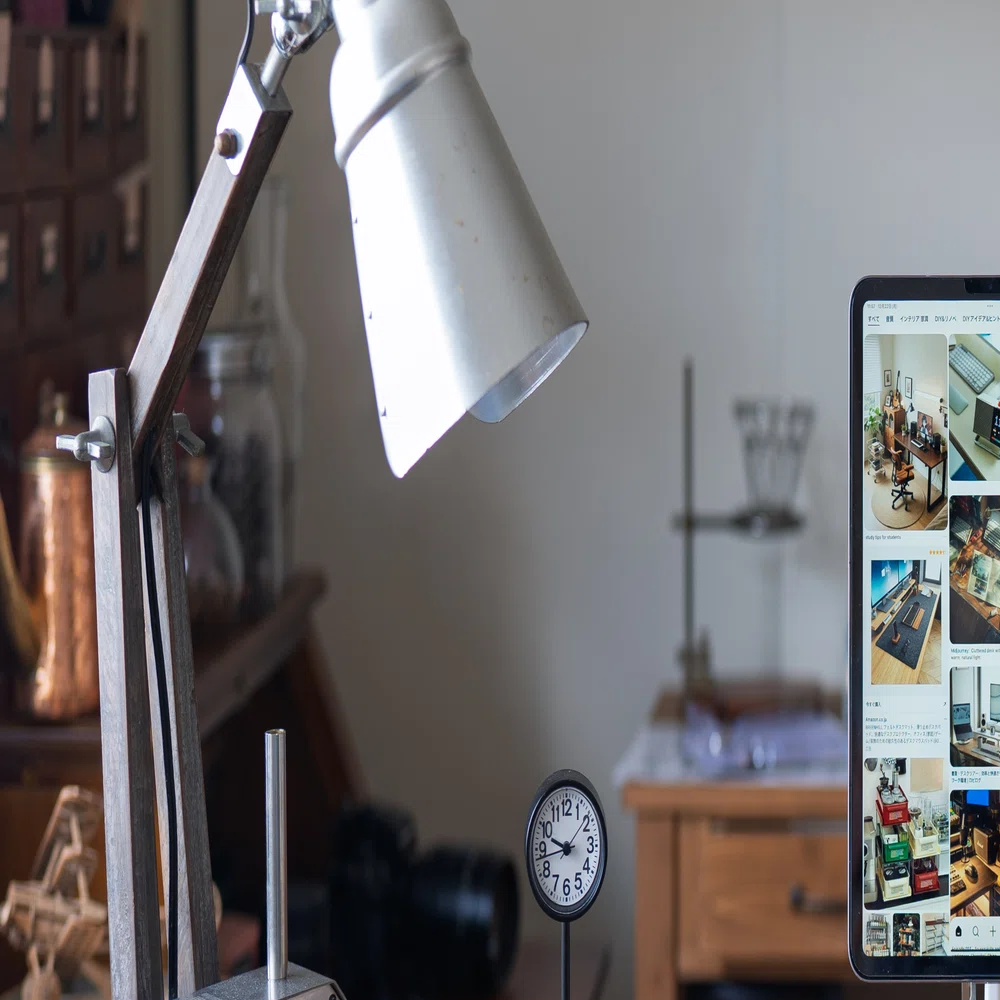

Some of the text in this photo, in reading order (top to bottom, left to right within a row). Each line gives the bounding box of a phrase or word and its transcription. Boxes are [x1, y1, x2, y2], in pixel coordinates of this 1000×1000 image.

[551, 804, 560, 822] 11
[561, 798, 572, 816] 12
[575, 803, 580, 820] 1
[541, 821, 553, 838] 10
[582, 815, 590, 832] 2
[539, 841, 547, 857] 9
[586, 836, 594, 853] 3
[543, 860, 551, 878] 8
[582, 857, 590, 874] 4
[552, 874, 560, 892] 7
[562, 878, 571, 896] 6
[574, 872, 582, 890] 5
